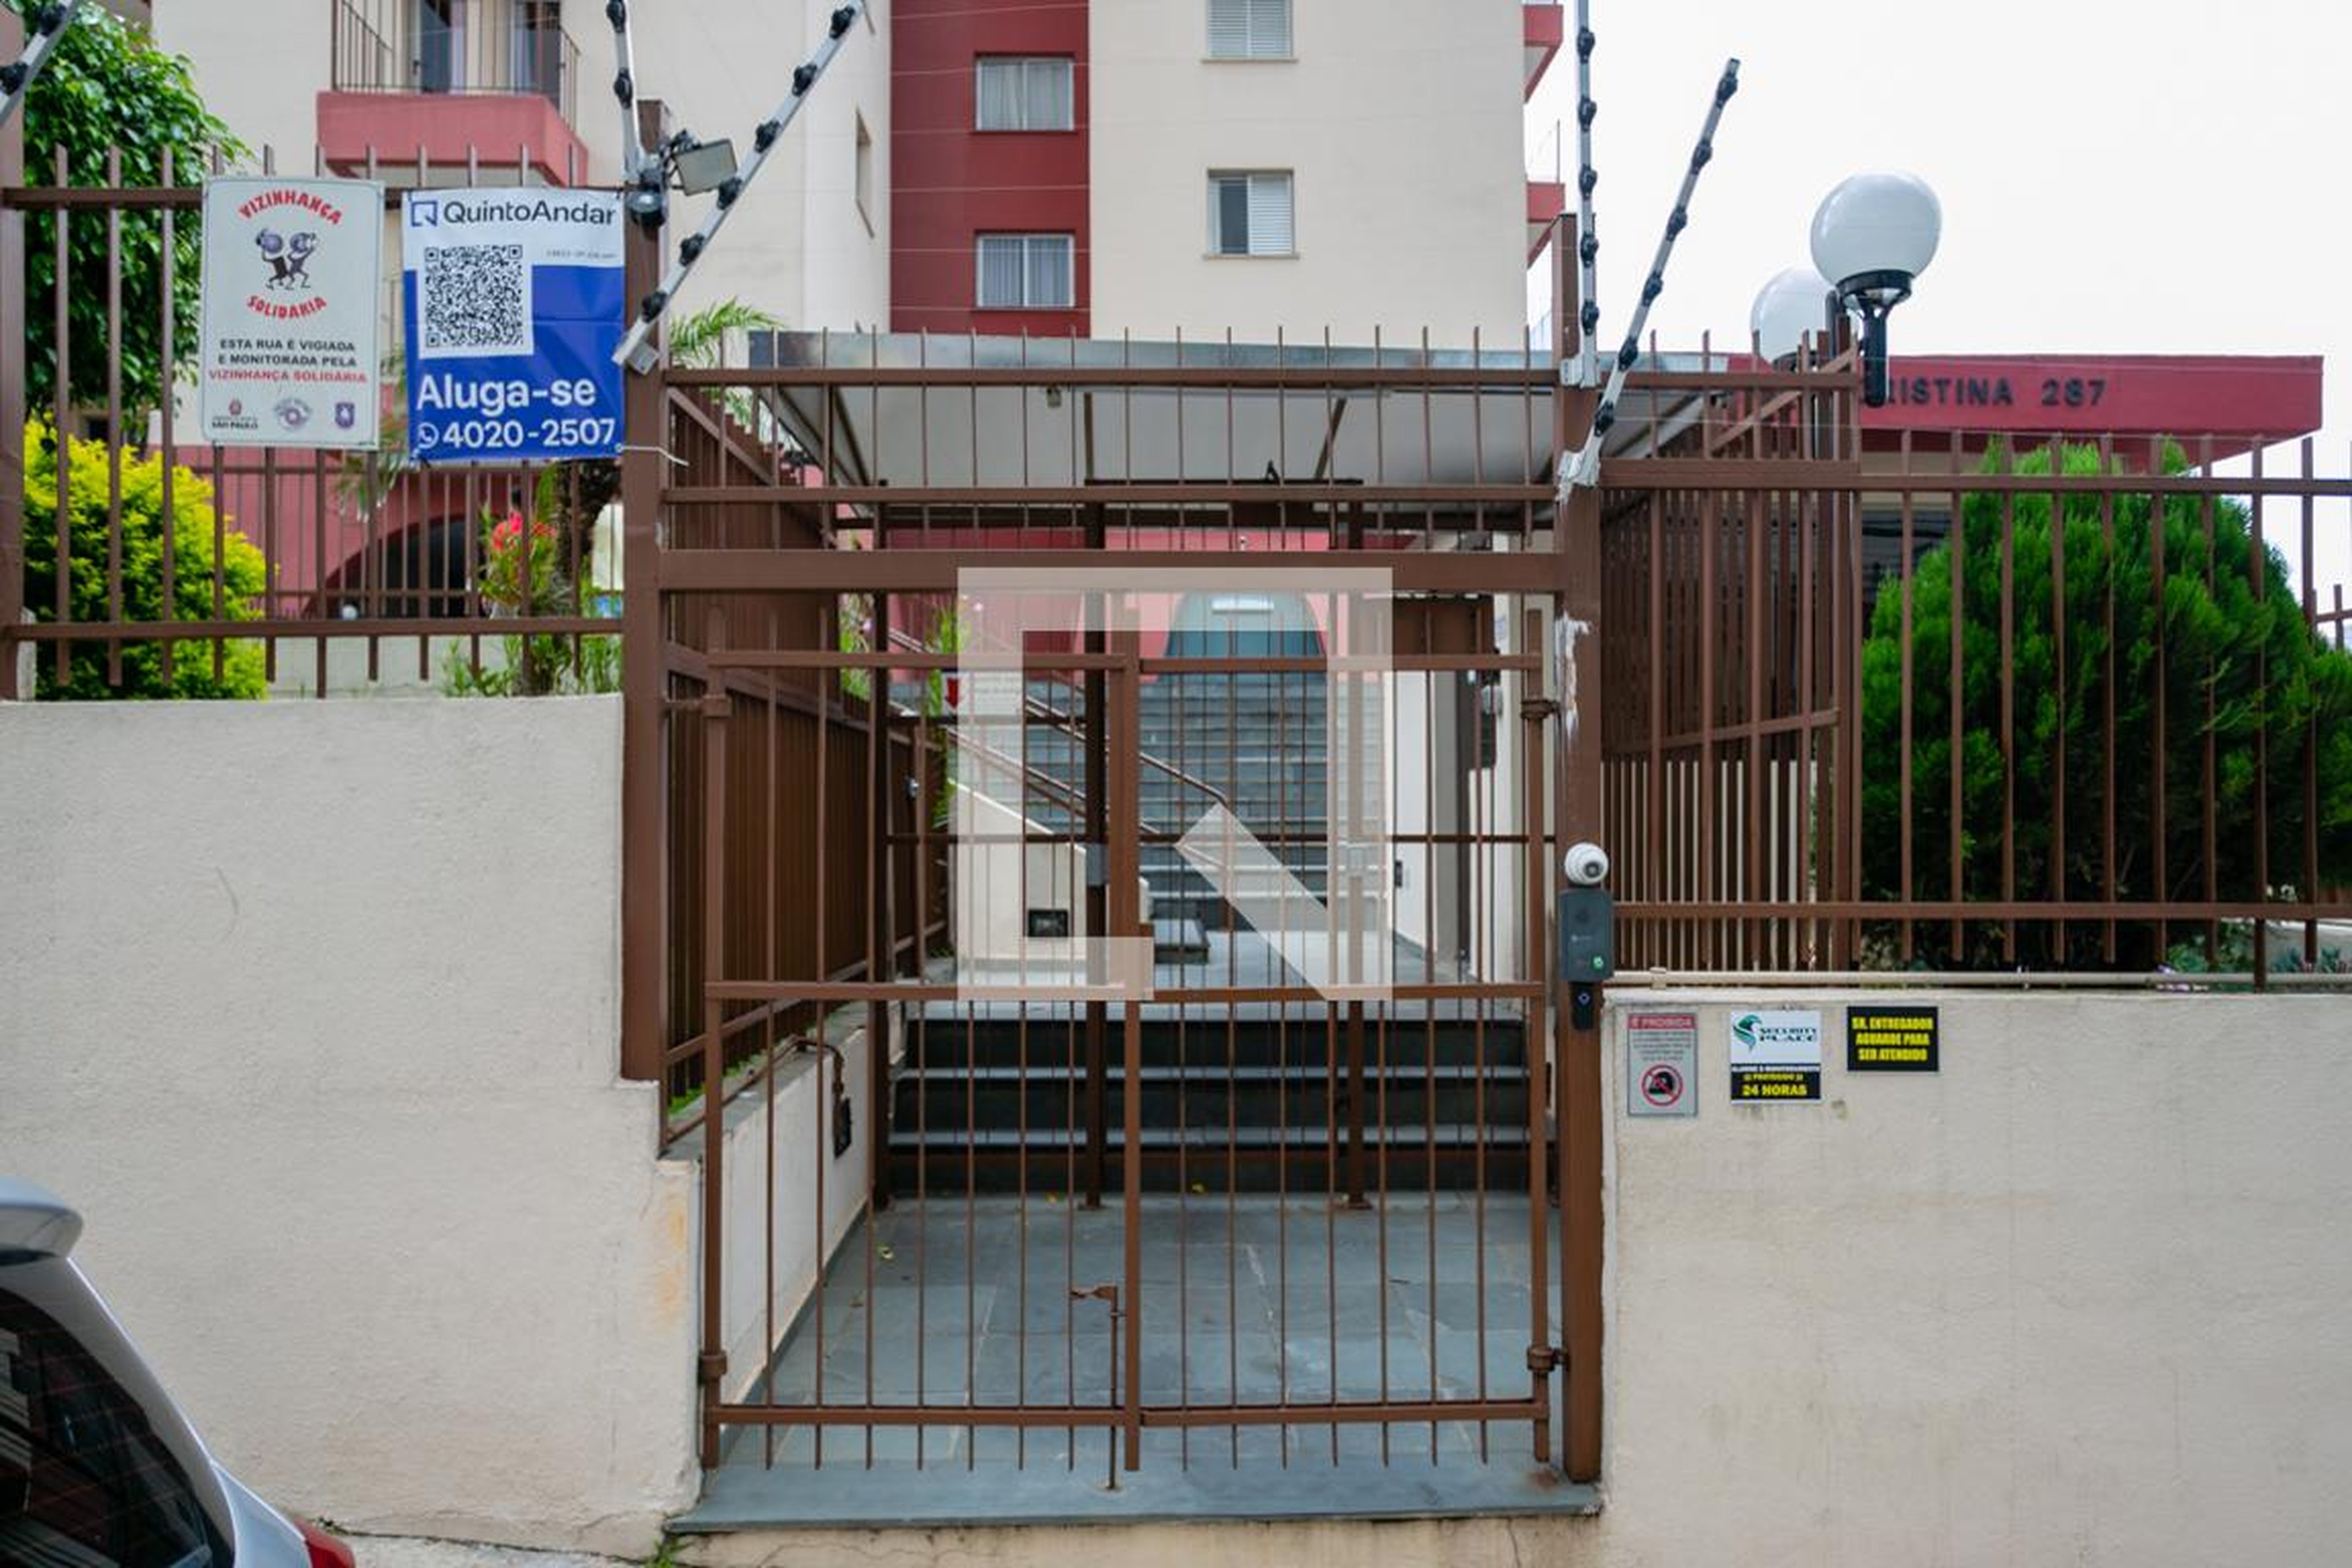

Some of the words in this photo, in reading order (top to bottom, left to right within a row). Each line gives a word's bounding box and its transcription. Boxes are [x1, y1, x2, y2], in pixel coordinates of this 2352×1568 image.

[443, 200, 616, 225] QuintoAndar
[220, 339, 252, 350] ESTA
[256, 339, 283, 350] RUA
[299, 339, 355, 352] VIGIADA
[218, 355, 226, 365] E
[230, 354, 317, 366] MONITORADA
[322, 356, 356, 368] PELA
[208, 369, 289, 383] VIZINHANÇA
[417, 374, 596, 418] Aluga-se
[1889, 376, 2013, 406] ISTINA
[443, 418, 616, 448] 4020-2507
[1869, 1016, 1934, 1030] ENTREGADOR
[1903, 1032, 1930, 1046] PARA
[1858, 1047, 1877, 1060] SER
[1878, 1047, 1928, 1060] ATENDIDO
[1743, 1084, 1758, 1096] 24
[1762, 1084, 1807, 1096] HORAS
